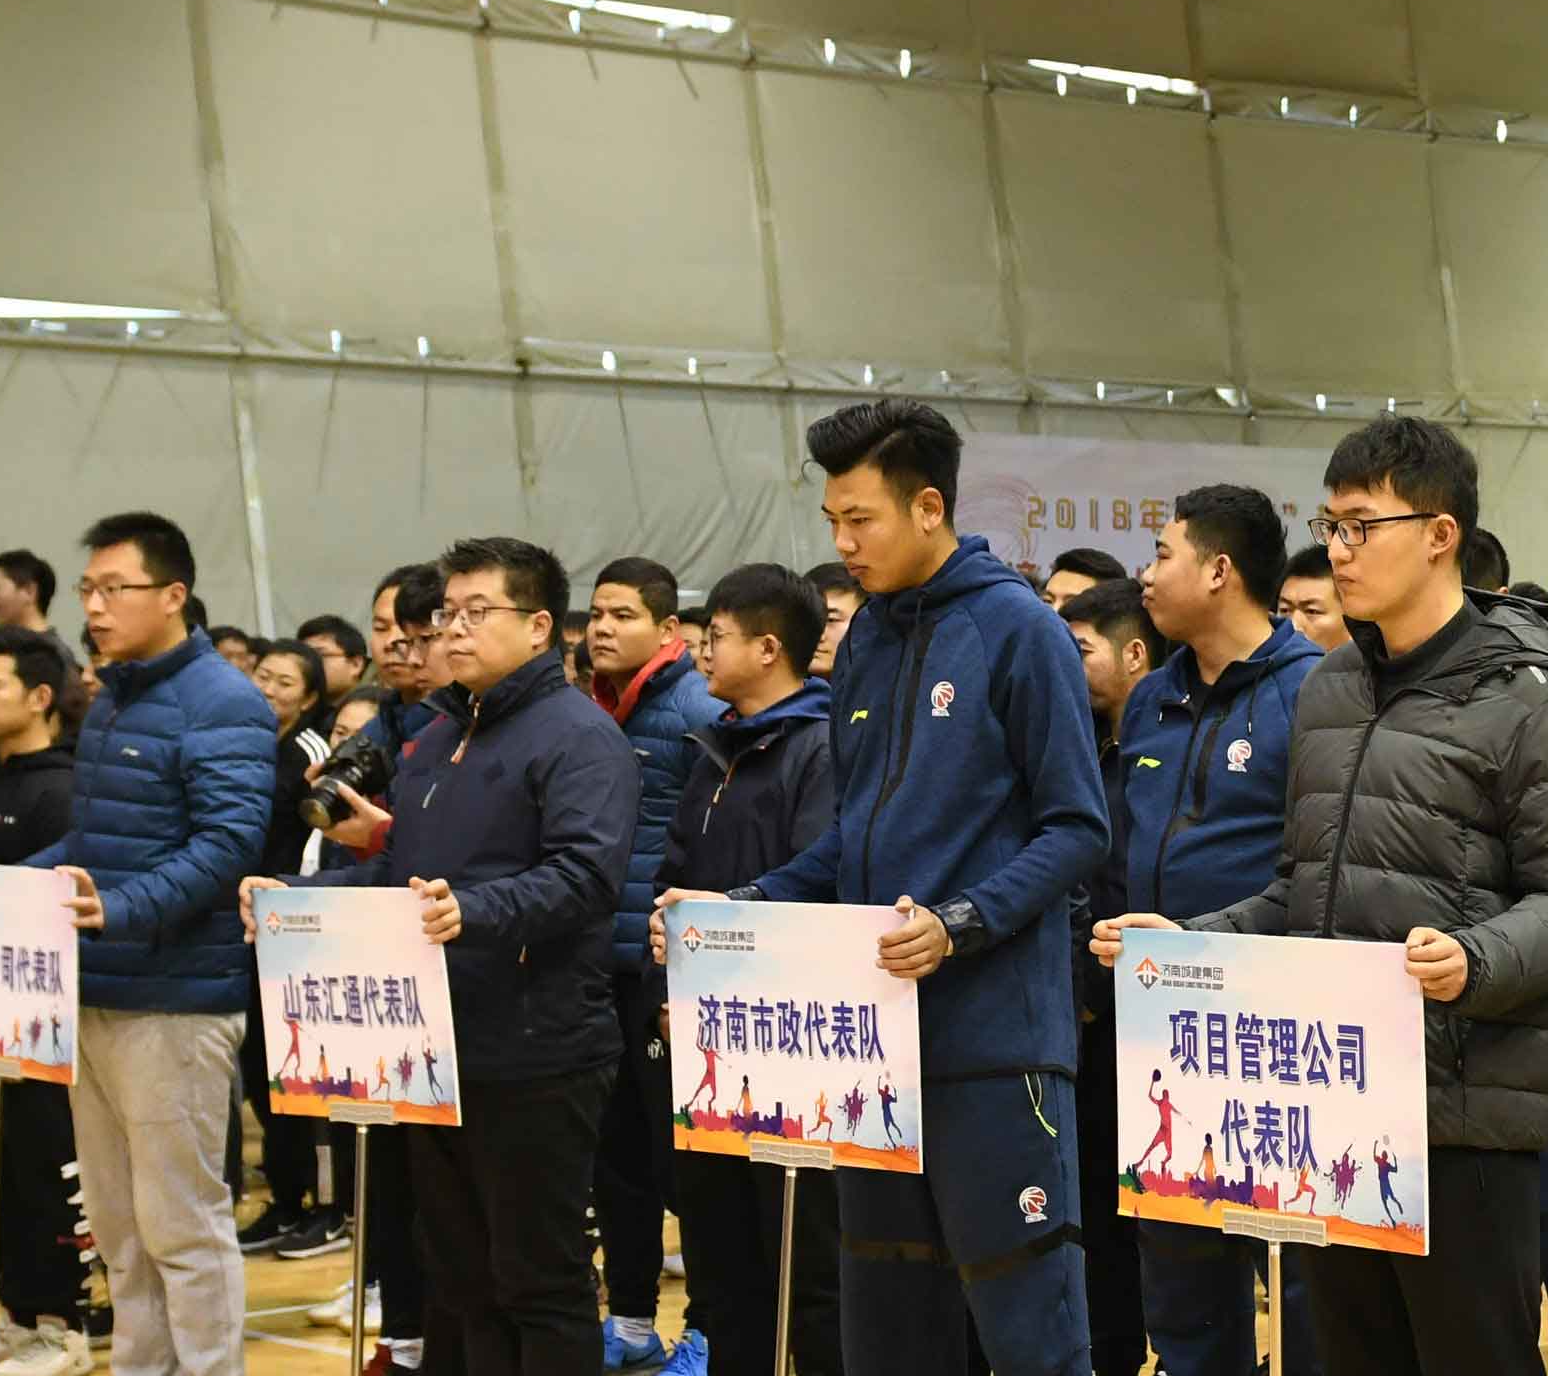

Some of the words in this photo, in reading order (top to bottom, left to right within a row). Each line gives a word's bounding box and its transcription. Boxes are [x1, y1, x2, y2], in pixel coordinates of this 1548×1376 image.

[282, 973, 427, 1027] 山东汇通代表队
[1160, 963, 1224, 982] 济南城建集团
[697, 993, 885, 1062] 济南市政代表队
[1168, 1009, 1367, 1093] 项目管理公司
[1219, 1098, 1320, 1173] 代表队
